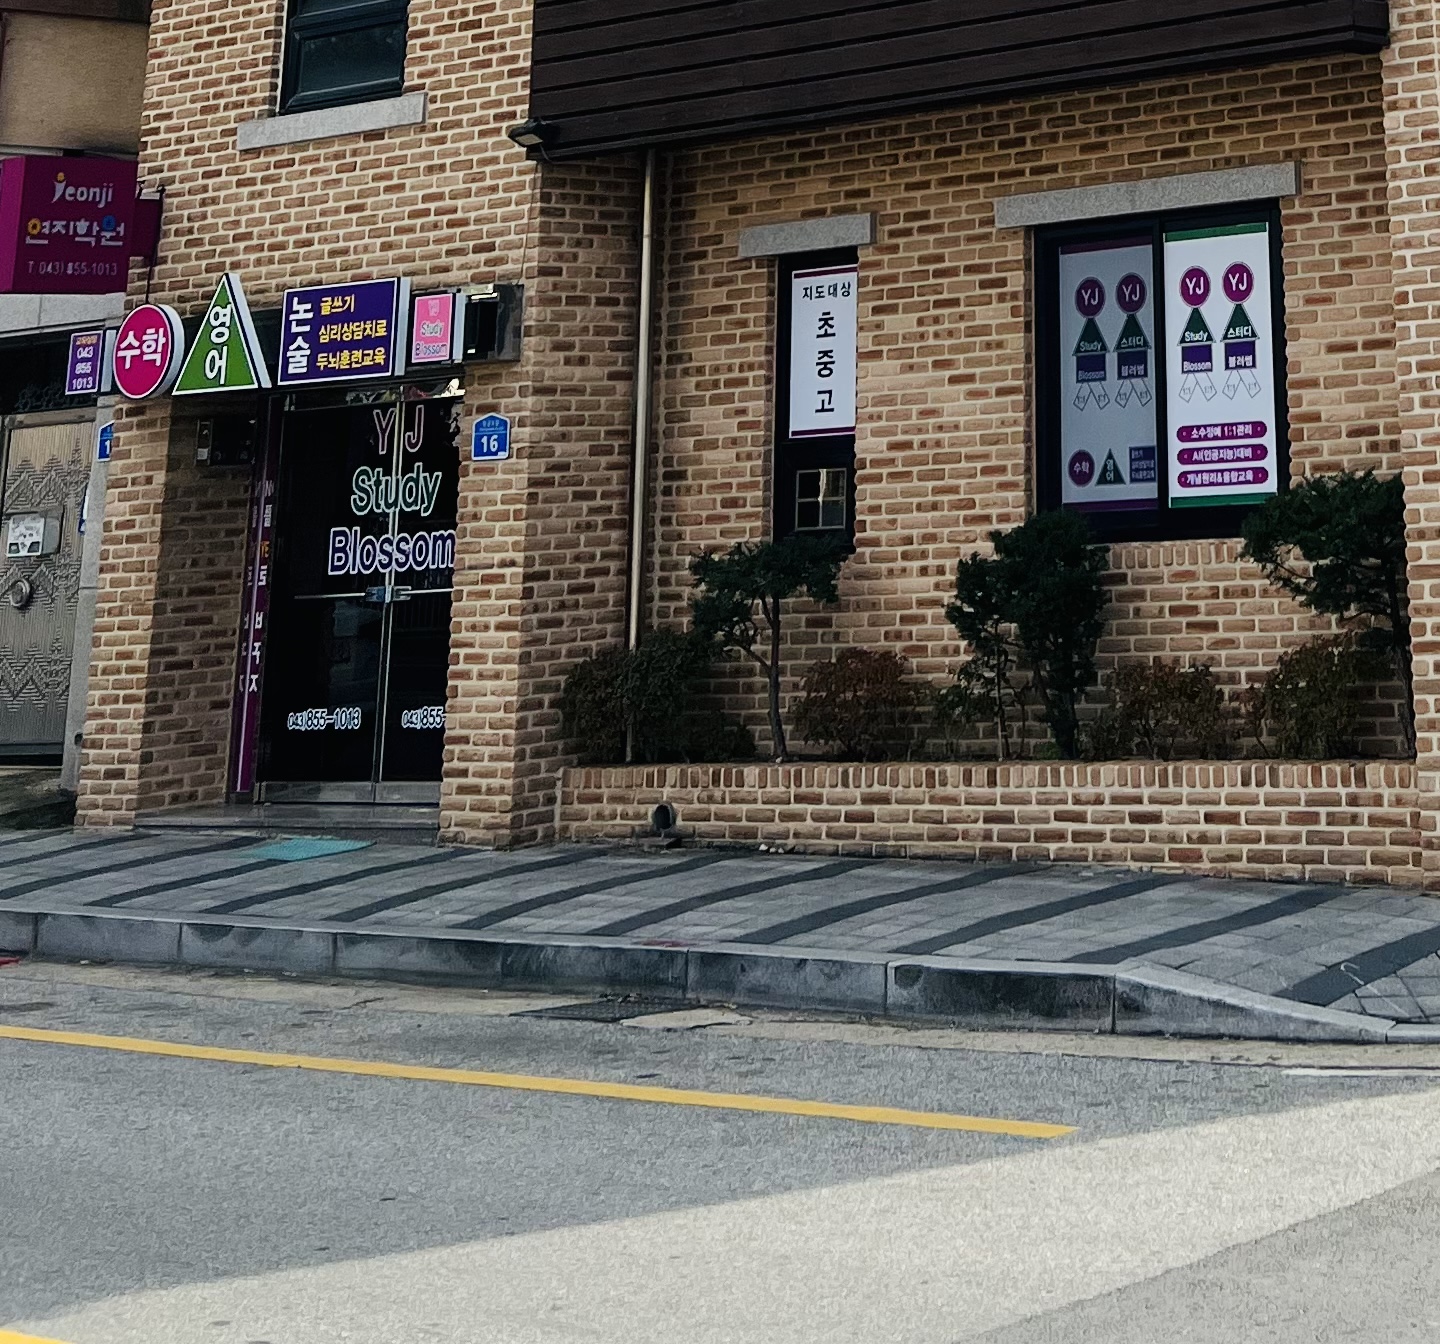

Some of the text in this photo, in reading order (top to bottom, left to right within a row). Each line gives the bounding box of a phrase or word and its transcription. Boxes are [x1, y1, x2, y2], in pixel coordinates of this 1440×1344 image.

[25, 215, 125, 248] 연지학원
[1186, 276, 1204, 295] YJ
[1228, 272, 1247, 291] YJ
[802, 281, 852, 301] 지도대상
[1081, 288, 1099, 306] YJ
[1122, 284, 1140, 302] YJ
[320, 294, 355, 315] 글쓰기
[286, 297, 314, 374] 논술
[318, 319, 388, 343] 심리상담치료
[421, 321, 444, 337] Study
[1184, 330, 1208, 342] Study
[1227, 325, 1252, 338] 스터디
[116, 327, 167, 370] 수학
[204, 303, 232, 385] 영어
[415, 342, 448, 357] Blossom
[1079, 340, 1102, 352] Study
[1120, 335, 1144, 347] 스터디
[76, 346, 94, 359] 043
[316, 346, 386, 371] 두뇌훈련교육
[1228, 354, 1253, 368] 블러썸
[75, 361, 92, 374] 855
[1183, 361, 1212, 372] Blossom
[72, 377, 93, 390] 1013
[480, 434, 499, 453] 16
[351, 462, 442, 517] Study
[328, 526, 456, 575] Blossom
